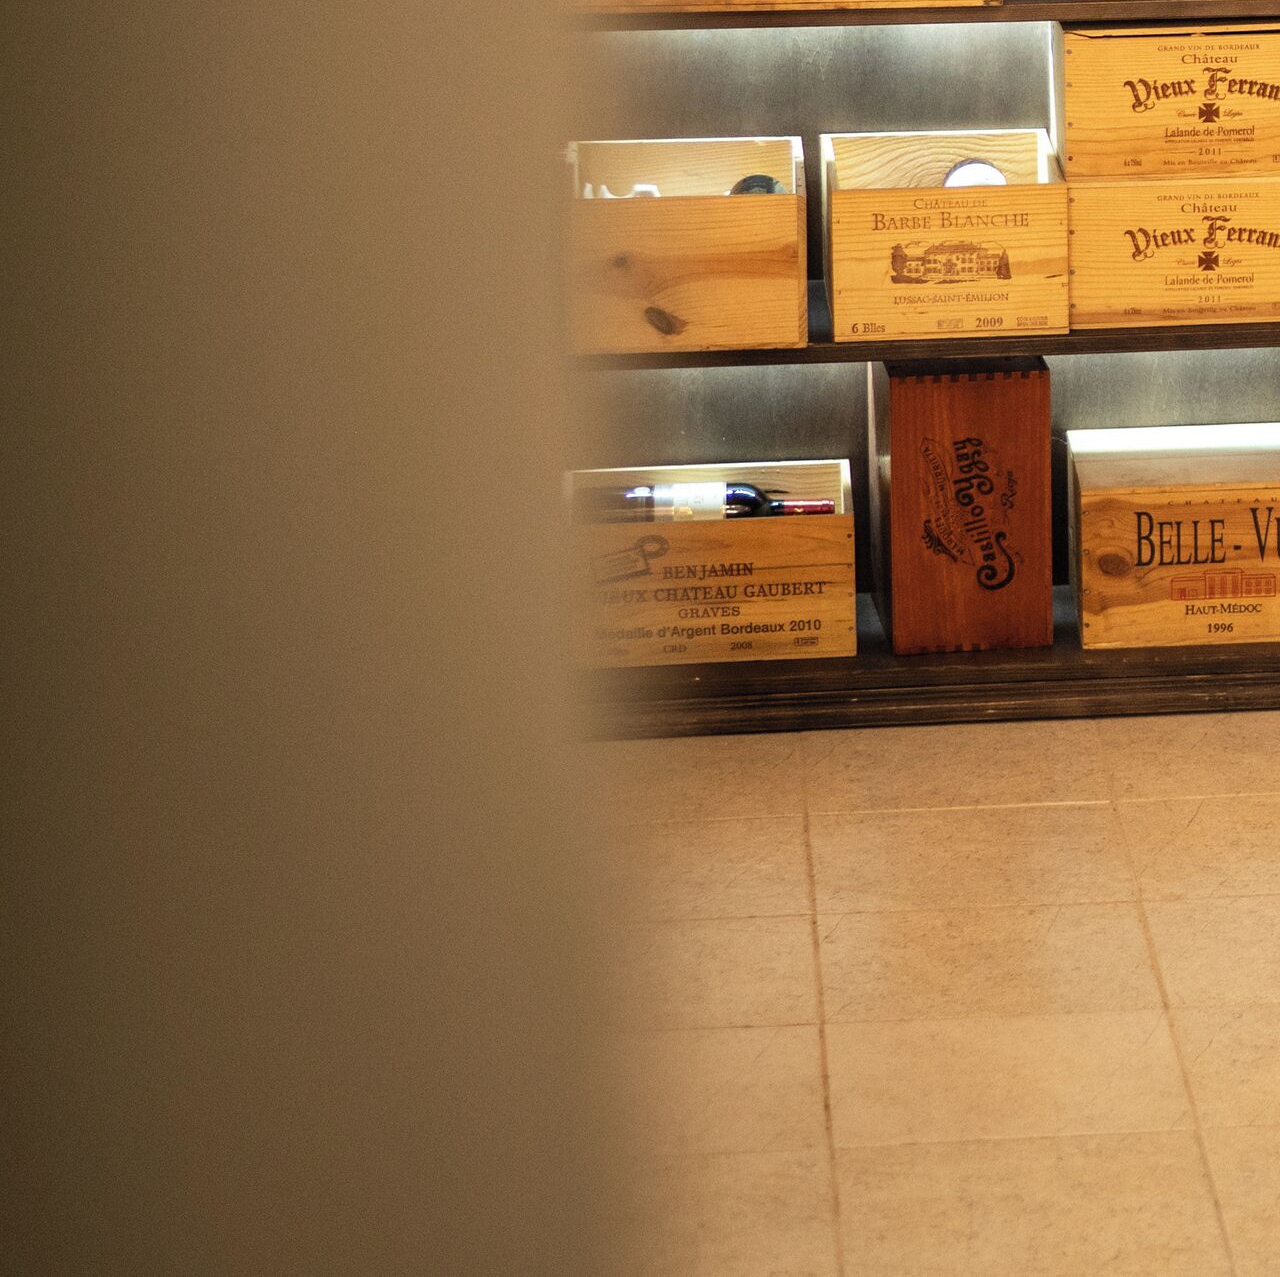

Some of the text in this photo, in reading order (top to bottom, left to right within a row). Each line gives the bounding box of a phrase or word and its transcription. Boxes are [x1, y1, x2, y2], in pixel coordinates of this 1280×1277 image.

[1181, 53, 1238, 64] Château
[1123, 78, 1197, 114] Vieux
[1165, 125, 1255, 138] Lalande de Pomerol
[1198, 148, 1222, 156] 2011
[1217, 192, 1260, 200] BORDEAUX
[914, 198, 987, 210] CHÂTEAU DE
[1180, 202, 1237, 213] Château
[872, 211, 1029, 231] BARBE BLANCHE
[1123, 227, 1196, 262] Vieux
[1165, 273, 1254, 286] Lalande de Pomerol
[894, 292, 1009, 305] LUSSAC-SAINT-ÉMILION
[1198, 296, 1222, 304] 2011
[852, 323, 858, 334] 6
[975, 317, 1004, 328] 2009
[1168, 497, 1278, 506] CHATEAU
[964, 504, 1016, 591] Castillo
[663, 562, 754, 580] BENJAMIN
[654, 584, 738, 602] CHATEAU
[744, 581, 827, 598] GAUBERT
[678, 606, 741, 619] GRAVES
[1185, 603, 1262, 615] HAUT-MÉDOC
[658, 624, 716, 640] d'Argent
[720, 622, 785, 635] Bordeaux
[790, 618, 822, 631] 2010
[1207, 623, 1234, 633] 1996
